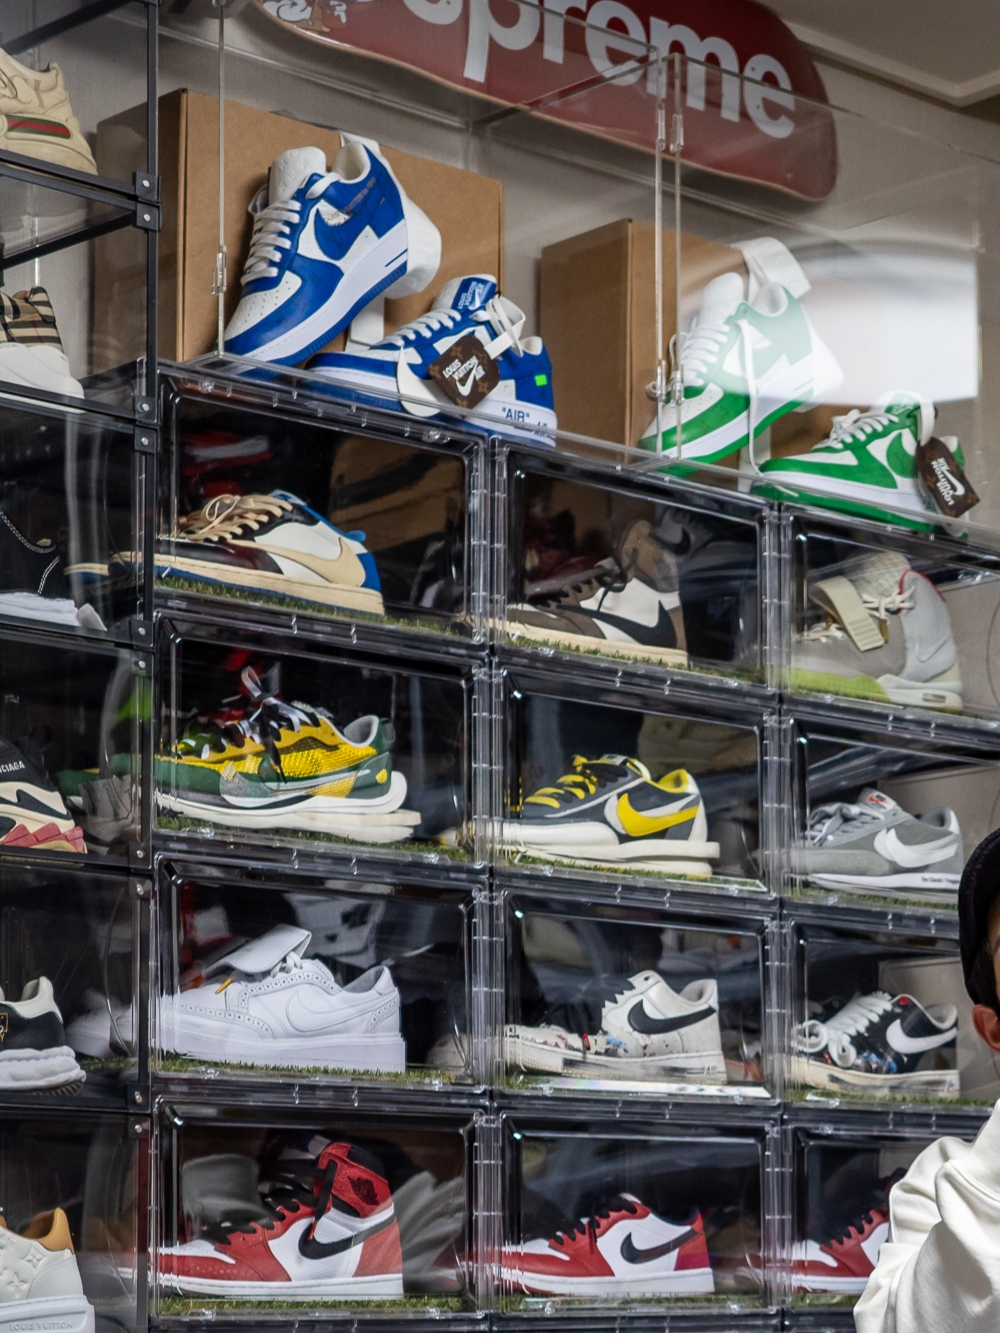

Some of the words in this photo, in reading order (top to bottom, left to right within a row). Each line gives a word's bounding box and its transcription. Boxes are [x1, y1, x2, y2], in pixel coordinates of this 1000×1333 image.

[443, 359, 462, 379] LOUIS
[502, 407, 530, 423] "AIR"
[9, 1323, 34, 1331] LOUIS
[37, 1321, 73, 1331] VUITTON
